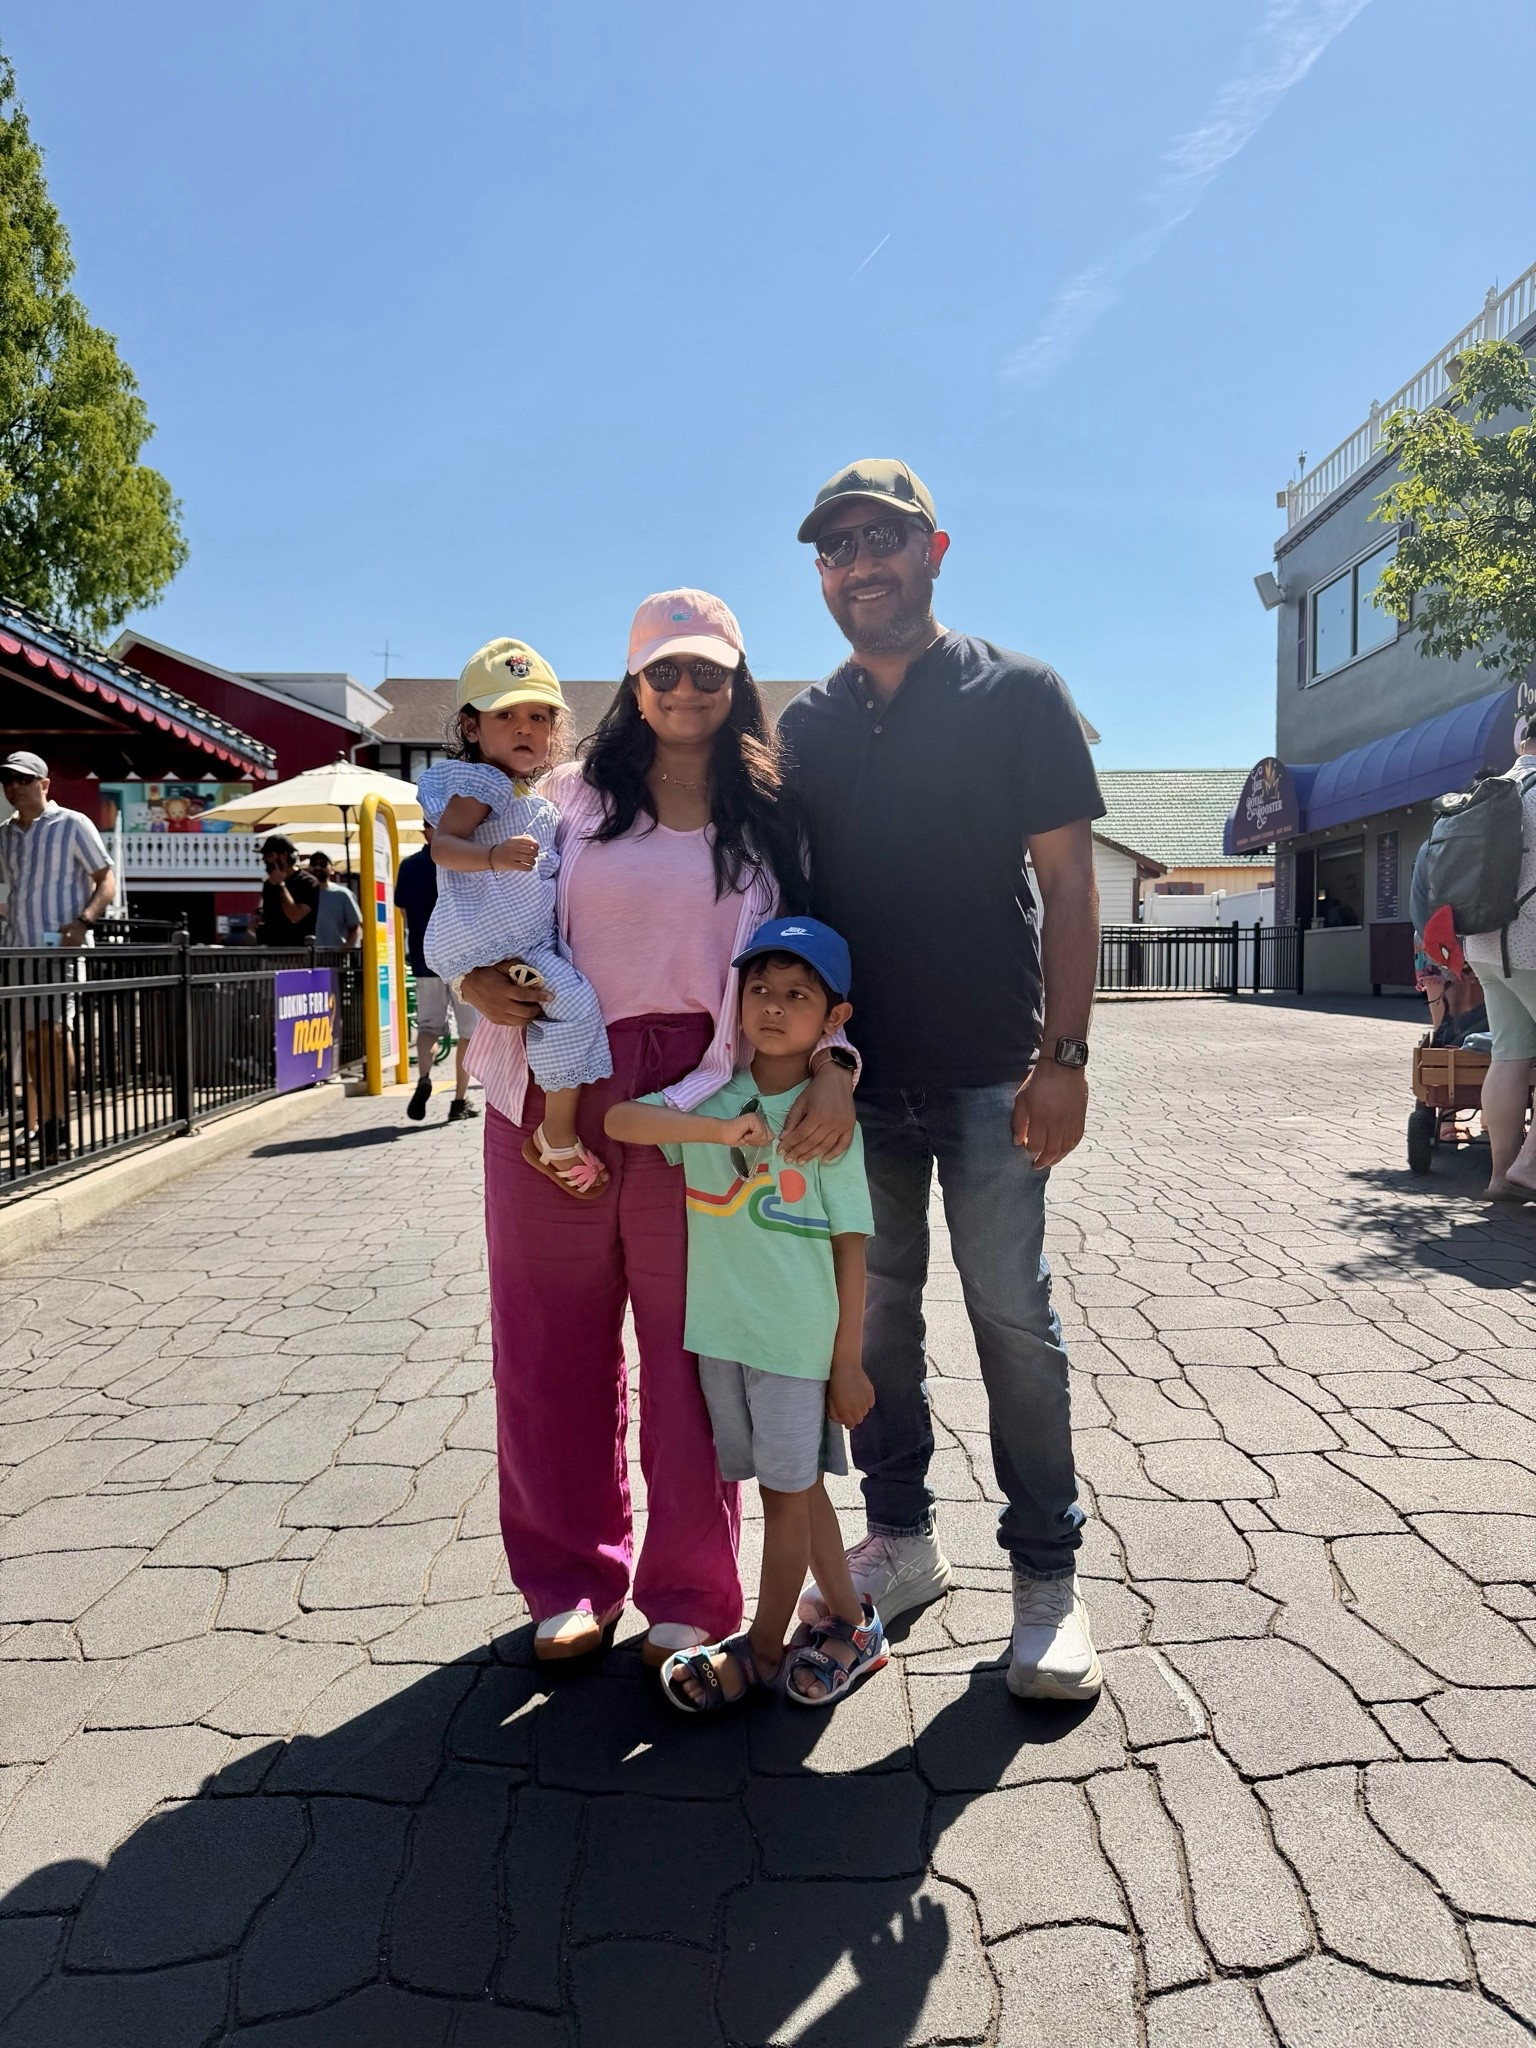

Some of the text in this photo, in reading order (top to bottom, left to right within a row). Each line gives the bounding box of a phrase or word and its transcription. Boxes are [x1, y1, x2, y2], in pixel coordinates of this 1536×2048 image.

[1253, 800, 1282, 829] ROOSTER
[278, 991, 329, 1020] LOOKING FOR A
